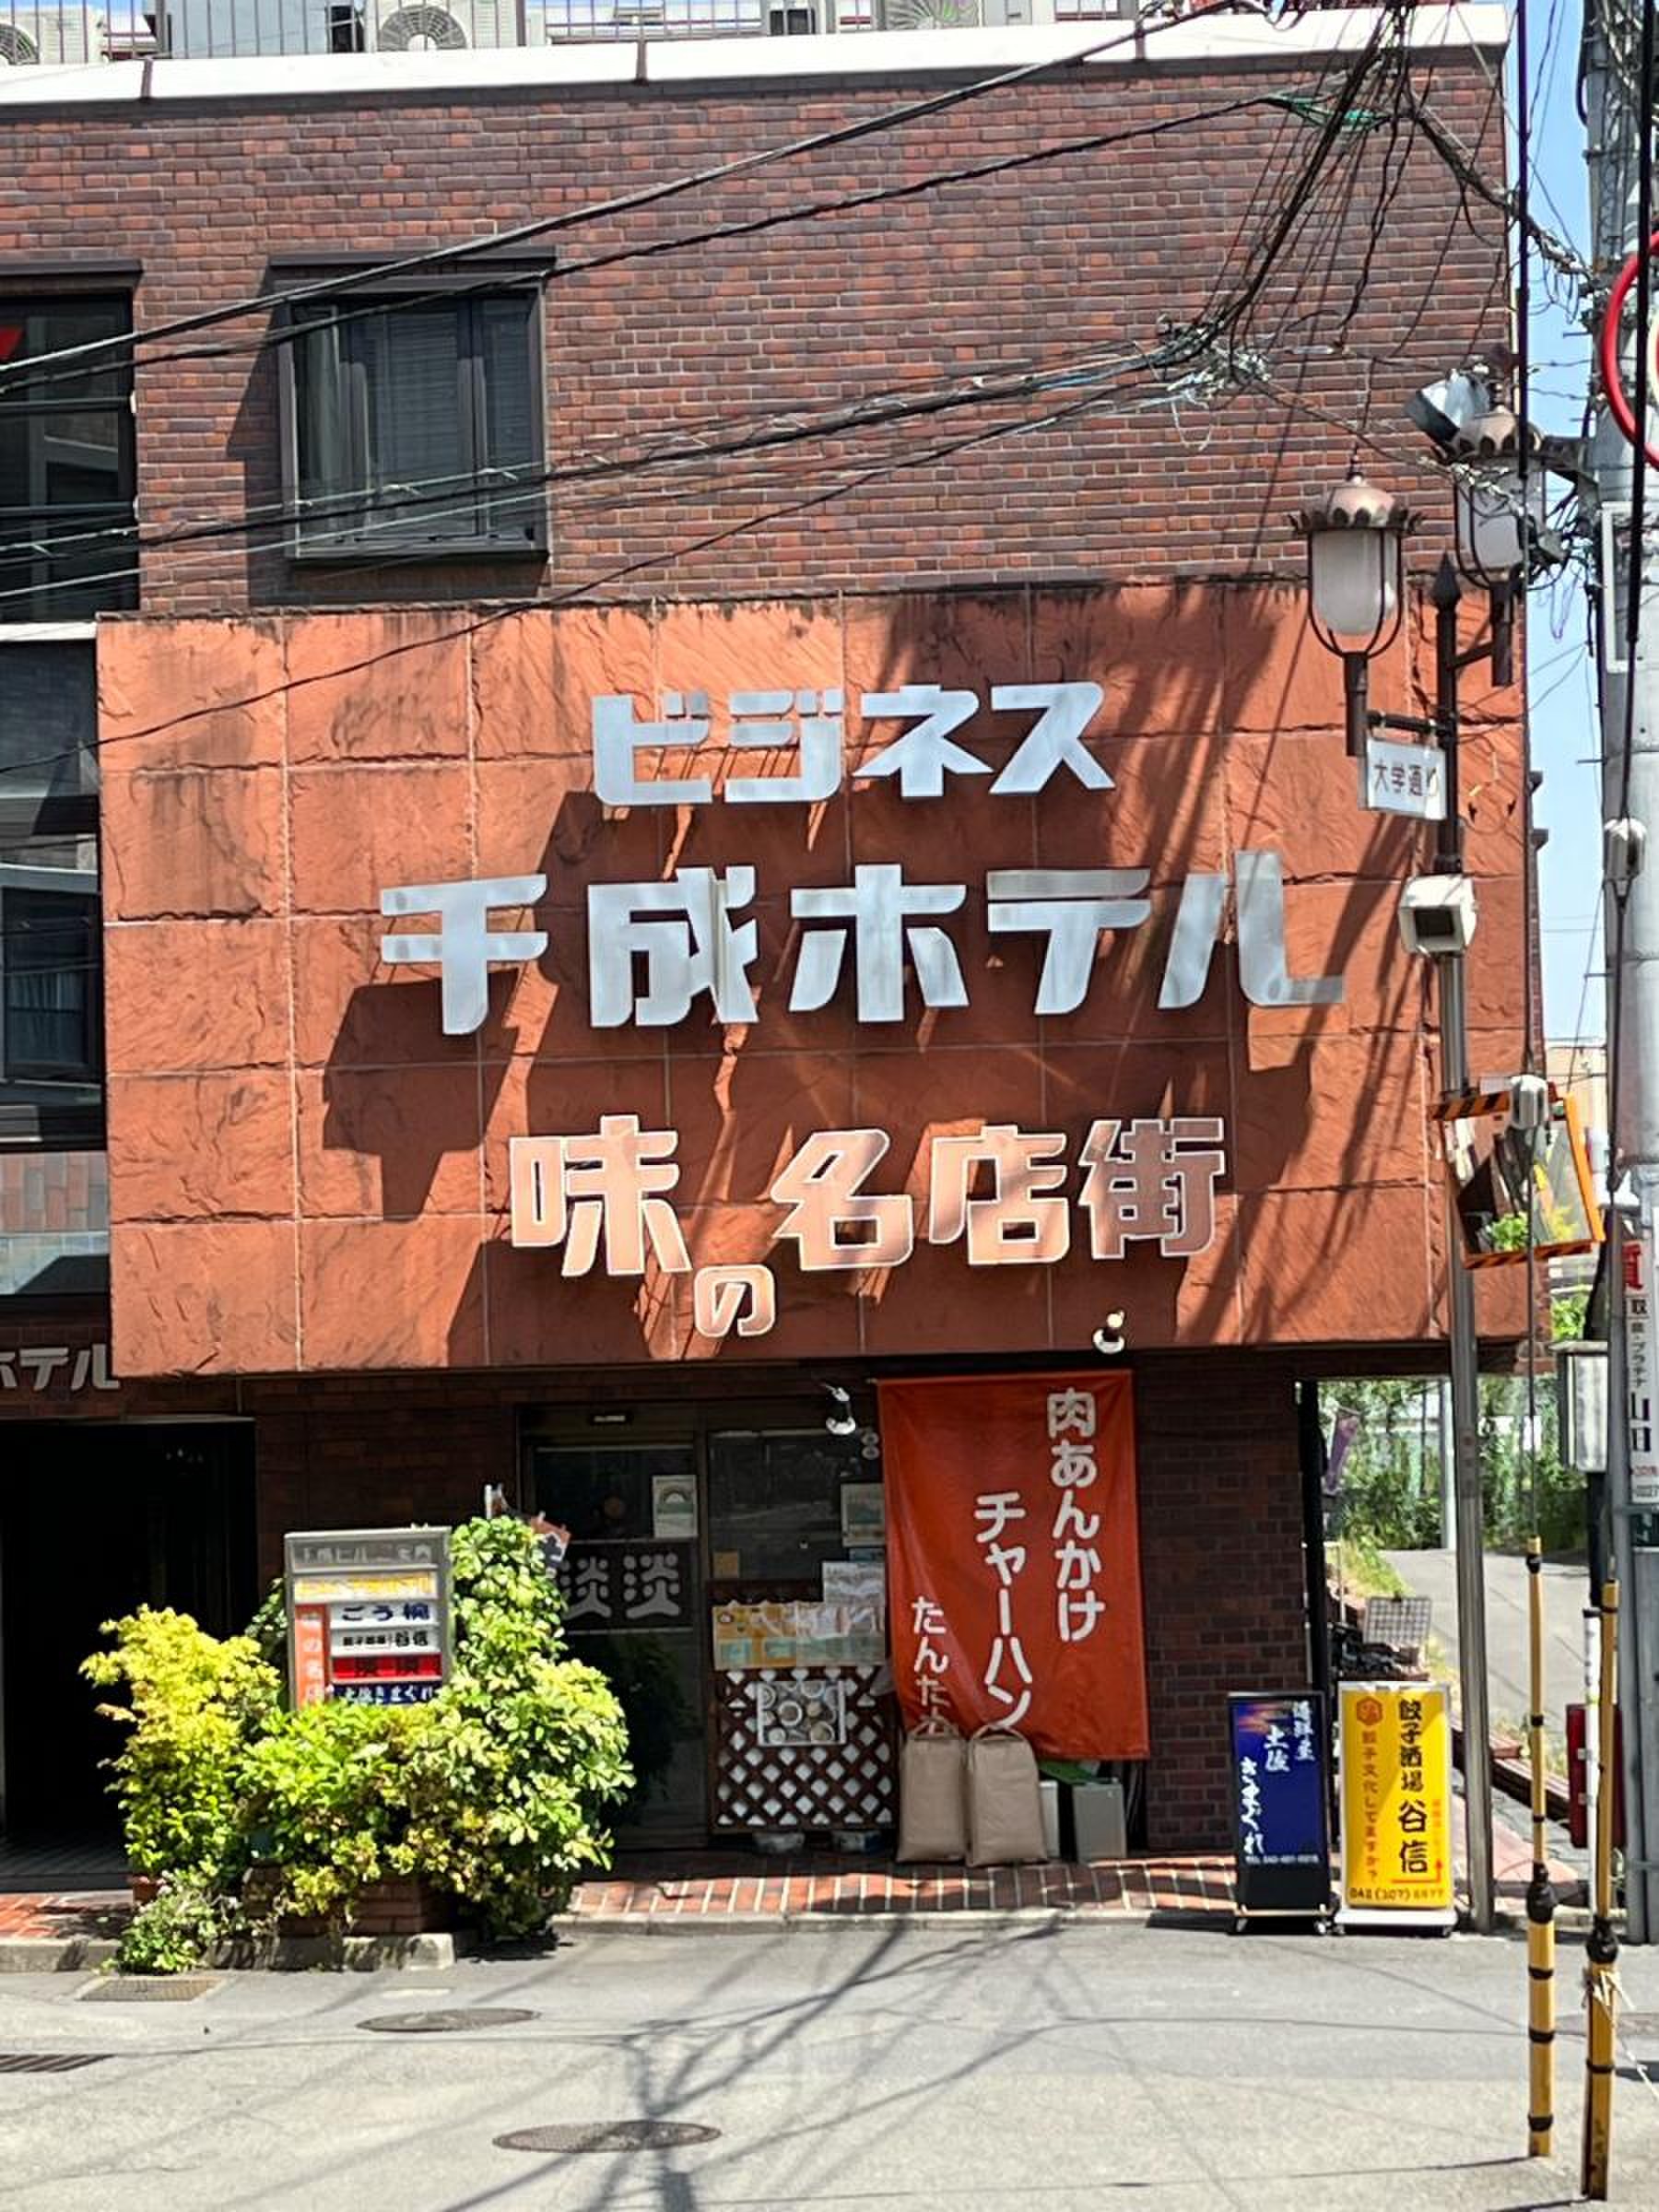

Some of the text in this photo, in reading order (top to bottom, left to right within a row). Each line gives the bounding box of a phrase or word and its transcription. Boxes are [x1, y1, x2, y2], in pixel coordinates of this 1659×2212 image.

[591, 681, 1116, 806] ビジネス
[380, 850, 1345, 1035] 千成ホテル
[509, 1113, 1226, 1337] 味の名店街
[974, 1490, 1033, 1729] チャーハン
[1047, 1387, 1106, 1642] 肉あんかけ
[1397, 1699, 1428, 1875] 餃子酒場 谷信
